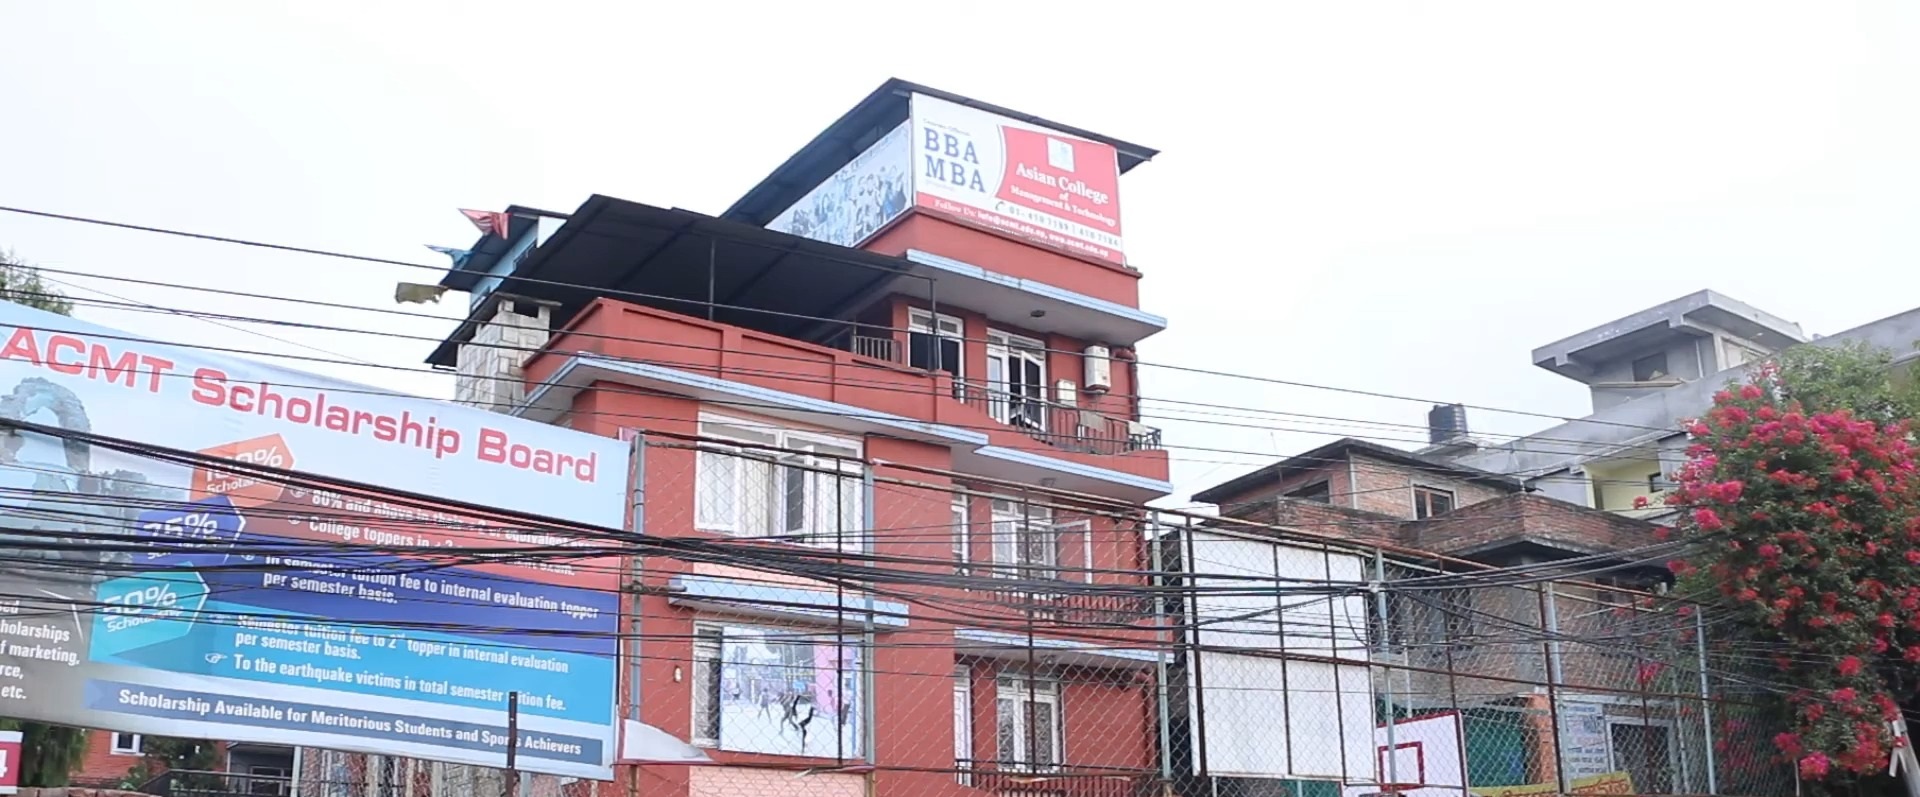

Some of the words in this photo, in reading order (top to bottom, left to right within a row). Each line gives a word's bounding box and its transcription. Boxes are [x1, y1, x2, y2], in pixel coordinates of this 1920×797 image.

[924, 126, 979, 164] BBA
[925, 154, 986, 193] MBA
[1016, 162, 1057, 187] Asian
[1058, 176, 1109, 205] College
[1010, 184, 1064, 210] Management
[1059, 192, 1070, 201] of
[0, 325, 174, 394] ACMT
[191, 367, 461, 460] Scholarship
[477, 427, 598, 483] Board
[345, 499, 371, 514] and
[143, 512, 218, 539] 75%
[309, 516, 360, 541] College
[364, 526, 414, 546] toppers
[102, 583, 177, 622] 50%
[263, 573, 287, 588] per
[290, 576, 356, 598] semester
[358, 583, 398, 604] basis.
[400, 574, 421, 590] fee
[424, 578, 437, 593] to
[440, 580, 490, 602] internal
[494, 593, 558, 613] evaluation
[561, 600, 600, 620] topper
[1, 619, 71, 644] holarships
[235, 632, 258, 648] per
[260, 636, 320, 656] semester
[323, 641, 362, 660] basis.
[304, 623, 346, 642] tuition
[350, 628, 369, 645] fee
[373, 632, 385, 647] to
[407, 638, 446, 658] topper
[448, 643, 461, 658] in
[463, 645, 509, 665] internal
[511, 654, 570, 674] evaluation
[1, 685, 27, 701] etc.
[233, 653, 251, 671] To
[255, 657, 276, 674] the
[279, 662, 353, 684] earthquake
[355, 670, 401, 691] victims
[404, 675, 416, 691] in
[419, 678, 448, 696] total
[450, 685, 504, 702] semester
[506, 691, 544, 708] ition
[546, 694, 567, 712] fee.
[118, 688, 210, 717] Scholarship
[214, 699, 284, 721] Available
[286, 707, 308, 723] for
[311, 710, 393, 733] Meritorious
[394, 719, 453, 741] Students
[455, 728, 480, 743] and
[481, 730, 522, 749] Spors
[524, 738, 583, 757] Achievers
